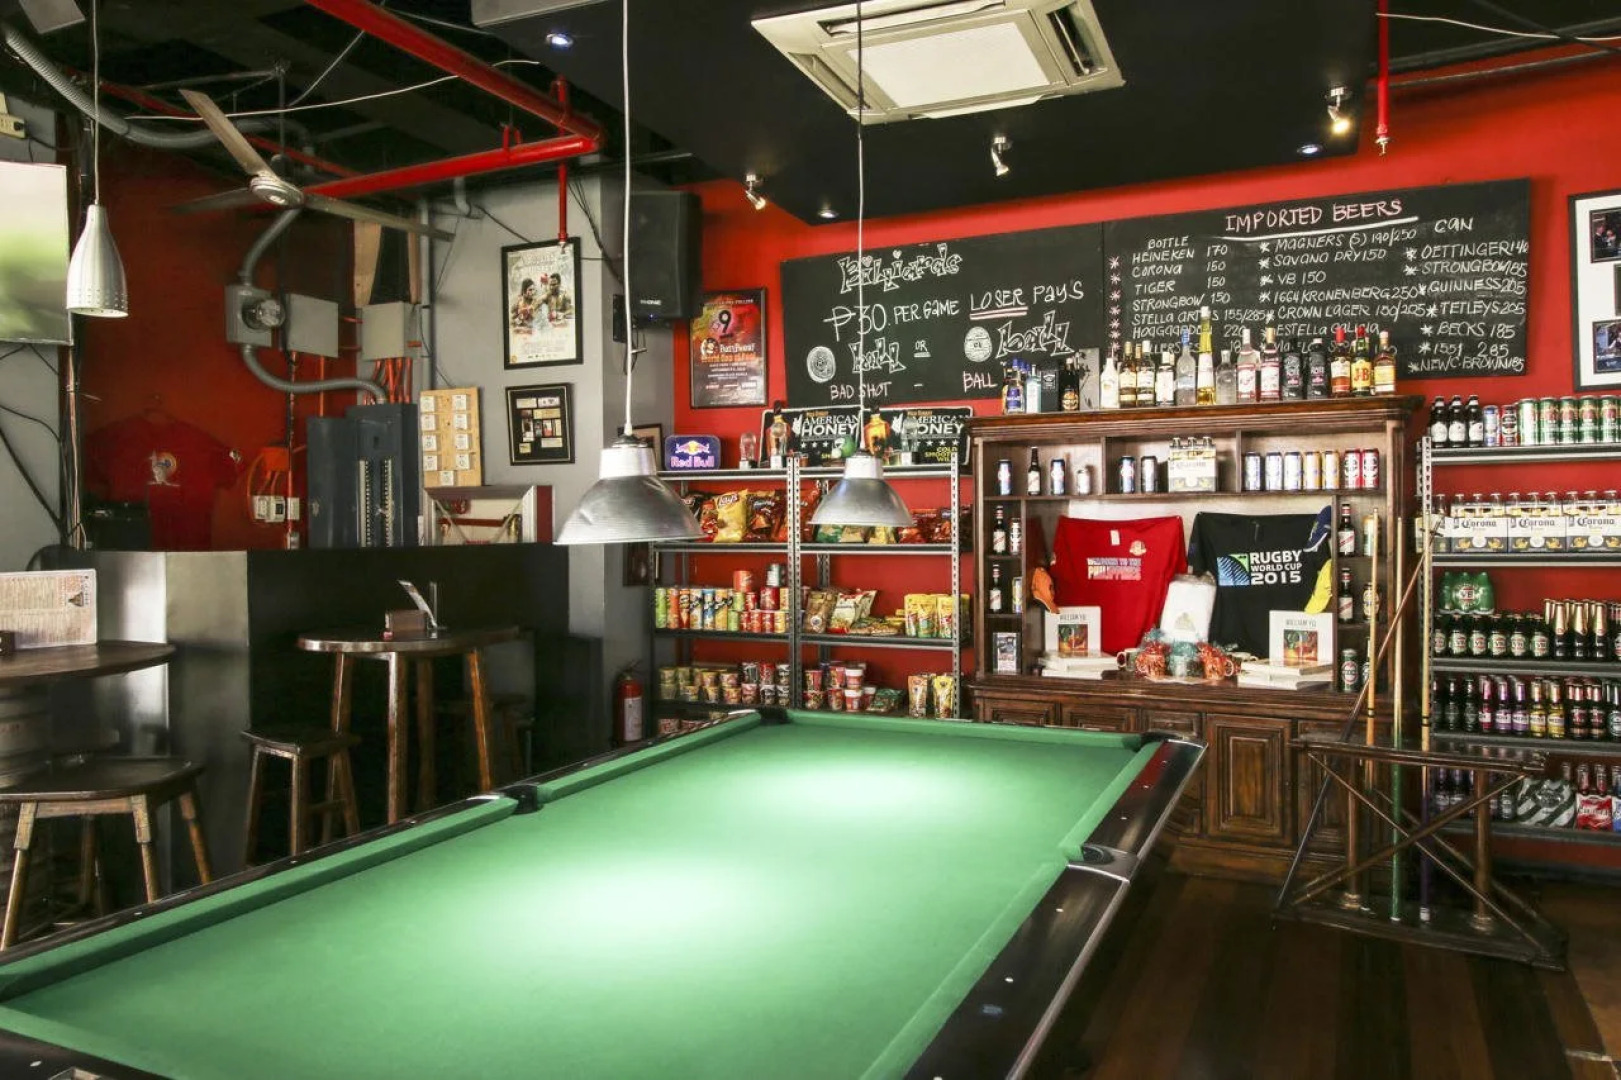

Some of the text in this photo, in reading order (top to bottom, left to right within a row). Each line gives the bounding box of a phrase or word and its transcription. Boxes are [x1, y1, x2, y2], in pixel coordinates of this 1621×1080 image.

[1225, 199, 1402, 233] IMPORTED BEERS
[1148, 236, 1189, 250] BOTTLE
[1421, 240, 1512, 259] OETTINGER
[1132, 244, 1228, 264] HEINEKEN 170
[1334, 249, 1361, 263] DRY
[1362, 248, 1387, 261] 150
[1278, 271, 1327, 285] VB 150
[1429, 277, 1501, 293] GUINNESS
[1135, 280, 1176, 296] TIGER
[970, 288, 1026, 311] LOSER
[1132, 292, 1231, 312] STRONGBOW 150
[893, 305, 921, 325] PER
[1277, 305, 1322, 319] CROWN
[1440, 300, 1526, 317] TETLEYS 205
[1437, 321, 1516, 339] BECKS 185
[963, 371, 998, 393] BALL
[830, 381, 892, 401] BAD SHOT
[803, 414, 860, 425] AMERICAN
[801, 423, 859, 437] HONEY
[916, 423, 965, 435] ONEY
[670, 455, 715, 467] Red Bull
[1461, 518, 1498, 527] Corona
[1519, 518, 1555, 527] Corona
[1577, 517, 1616, 526] Corona
[1250, 550, 1302, 565] RUGBY
[1250, 563, 1302, 572] WORLD CUP
[1250, 571, 1302, 585] 2015
